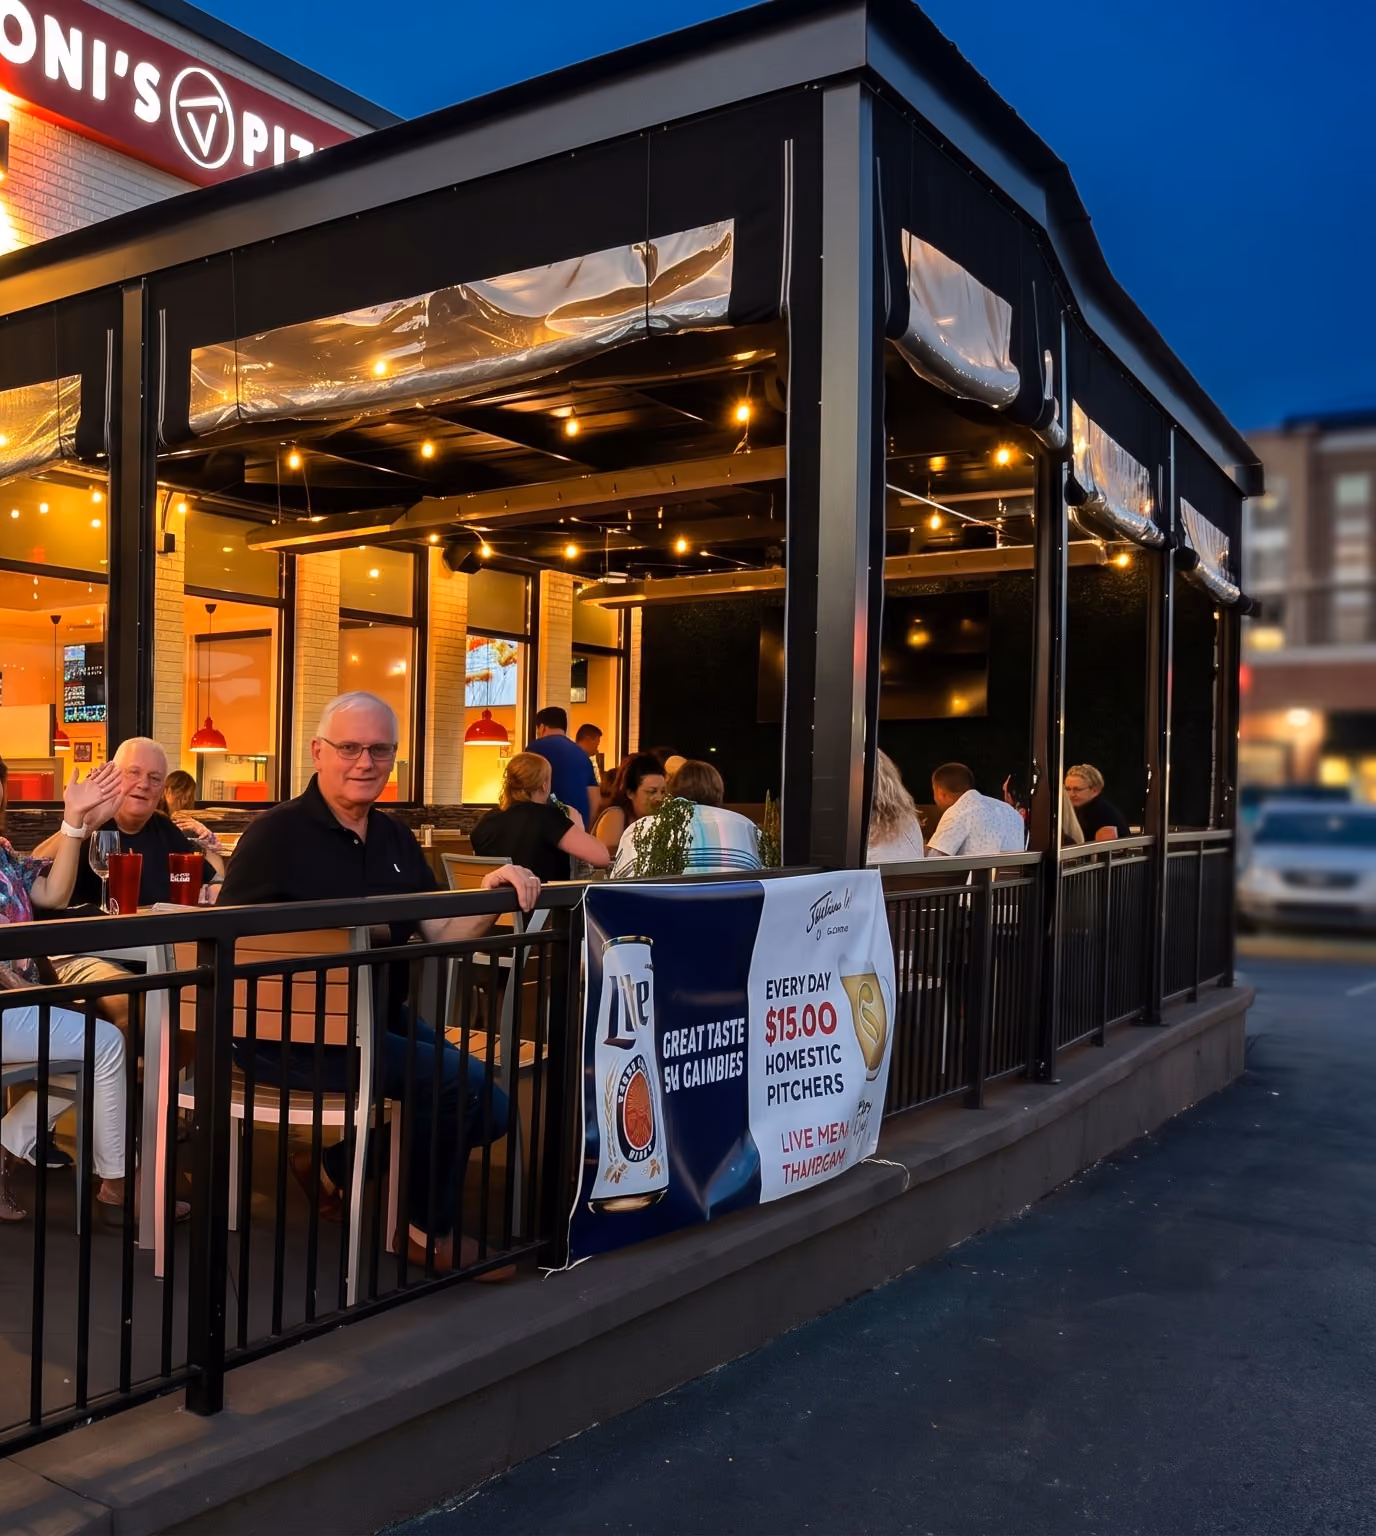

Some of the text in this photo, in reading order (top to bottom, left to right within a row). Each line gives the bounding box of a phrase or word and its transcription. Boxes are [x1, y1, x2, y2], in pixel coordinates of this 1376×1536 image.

[766, 972, 832, 1000] EVERY DAY
[603, 974, 650, 1051] Lite
[765, 1001, 837, 1047] $15.00
[663, 1017, 745, 1059] GREAT TASTE
[766, 1044, 842, 1076] HOMESTIC
[767, 1073, 844, 1106] PITCHERS
[781, 1128, 814, 1153] LIVE
